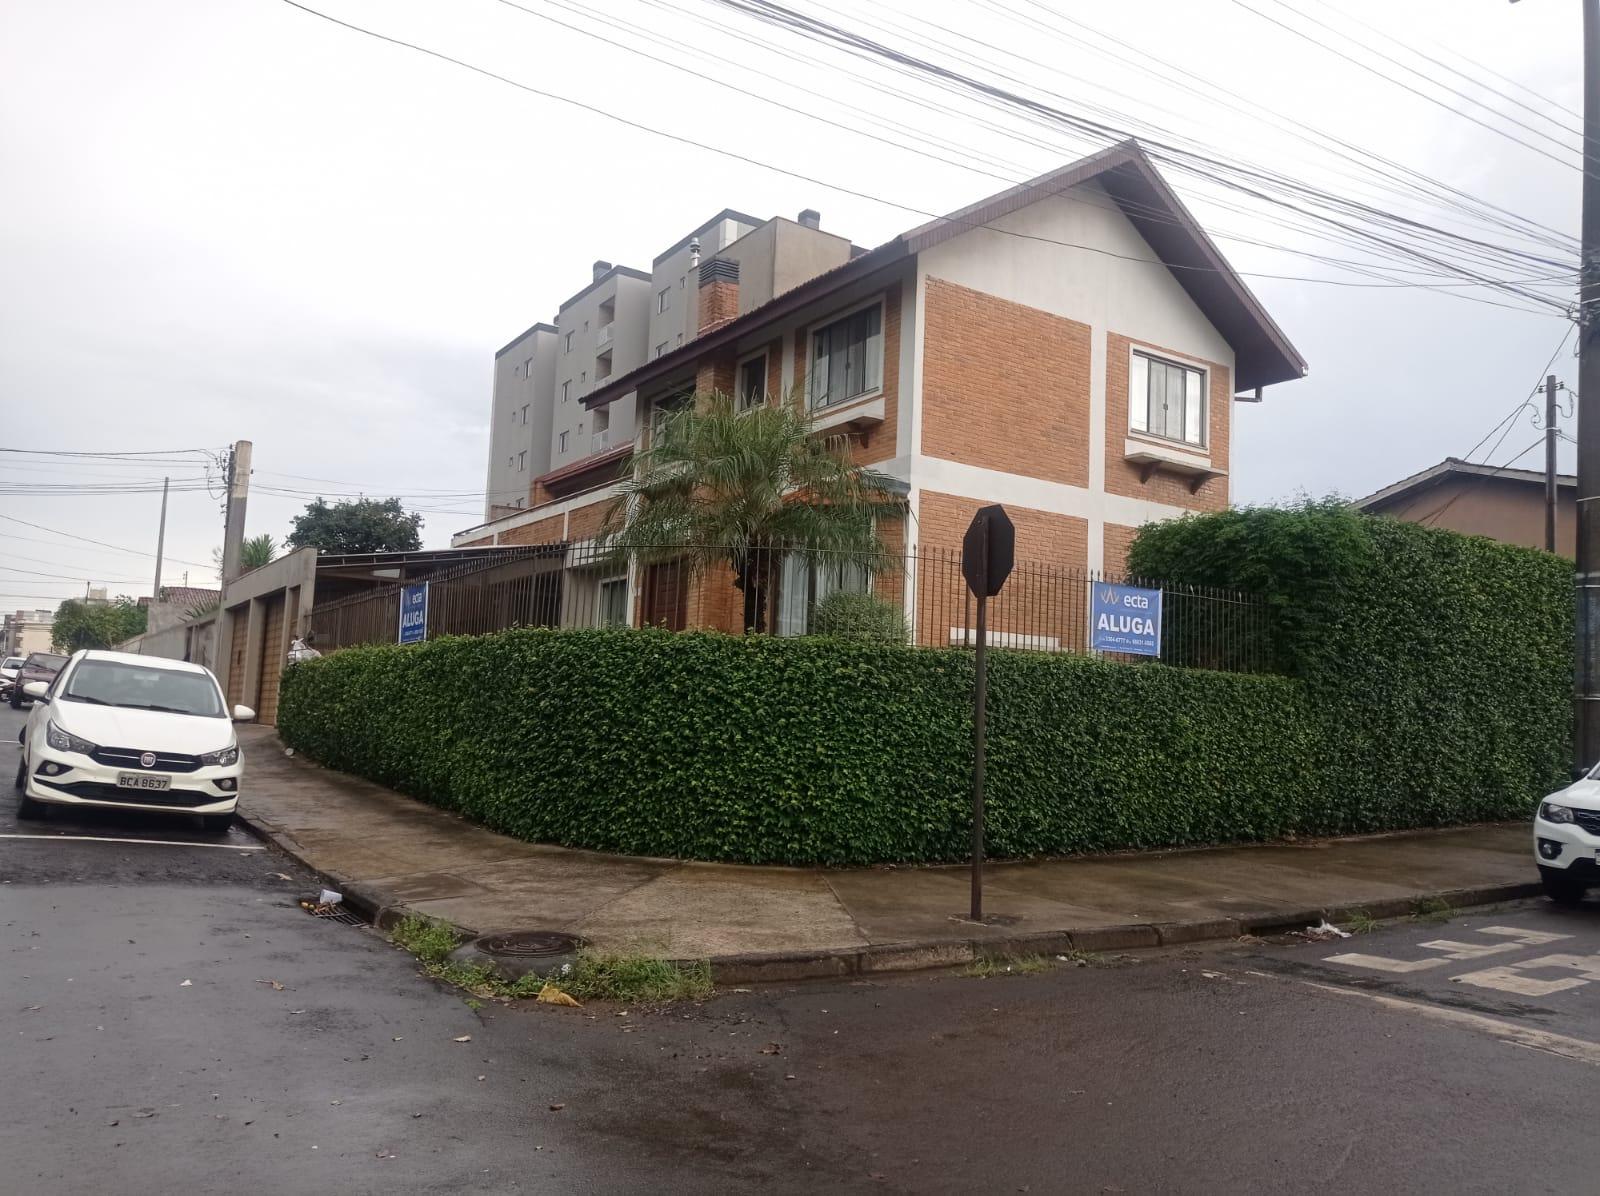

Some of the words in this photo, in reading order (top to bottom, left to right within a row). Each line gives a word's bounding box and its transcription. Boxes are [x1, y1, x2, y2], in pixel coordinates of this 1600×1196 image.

[1124, 595, 1149, 609] ecta
[403, 610, 424, 628] ALUGA
[1096, 613, 1155, 636] ALUGA
[120, 776, 139, 787] BCA
